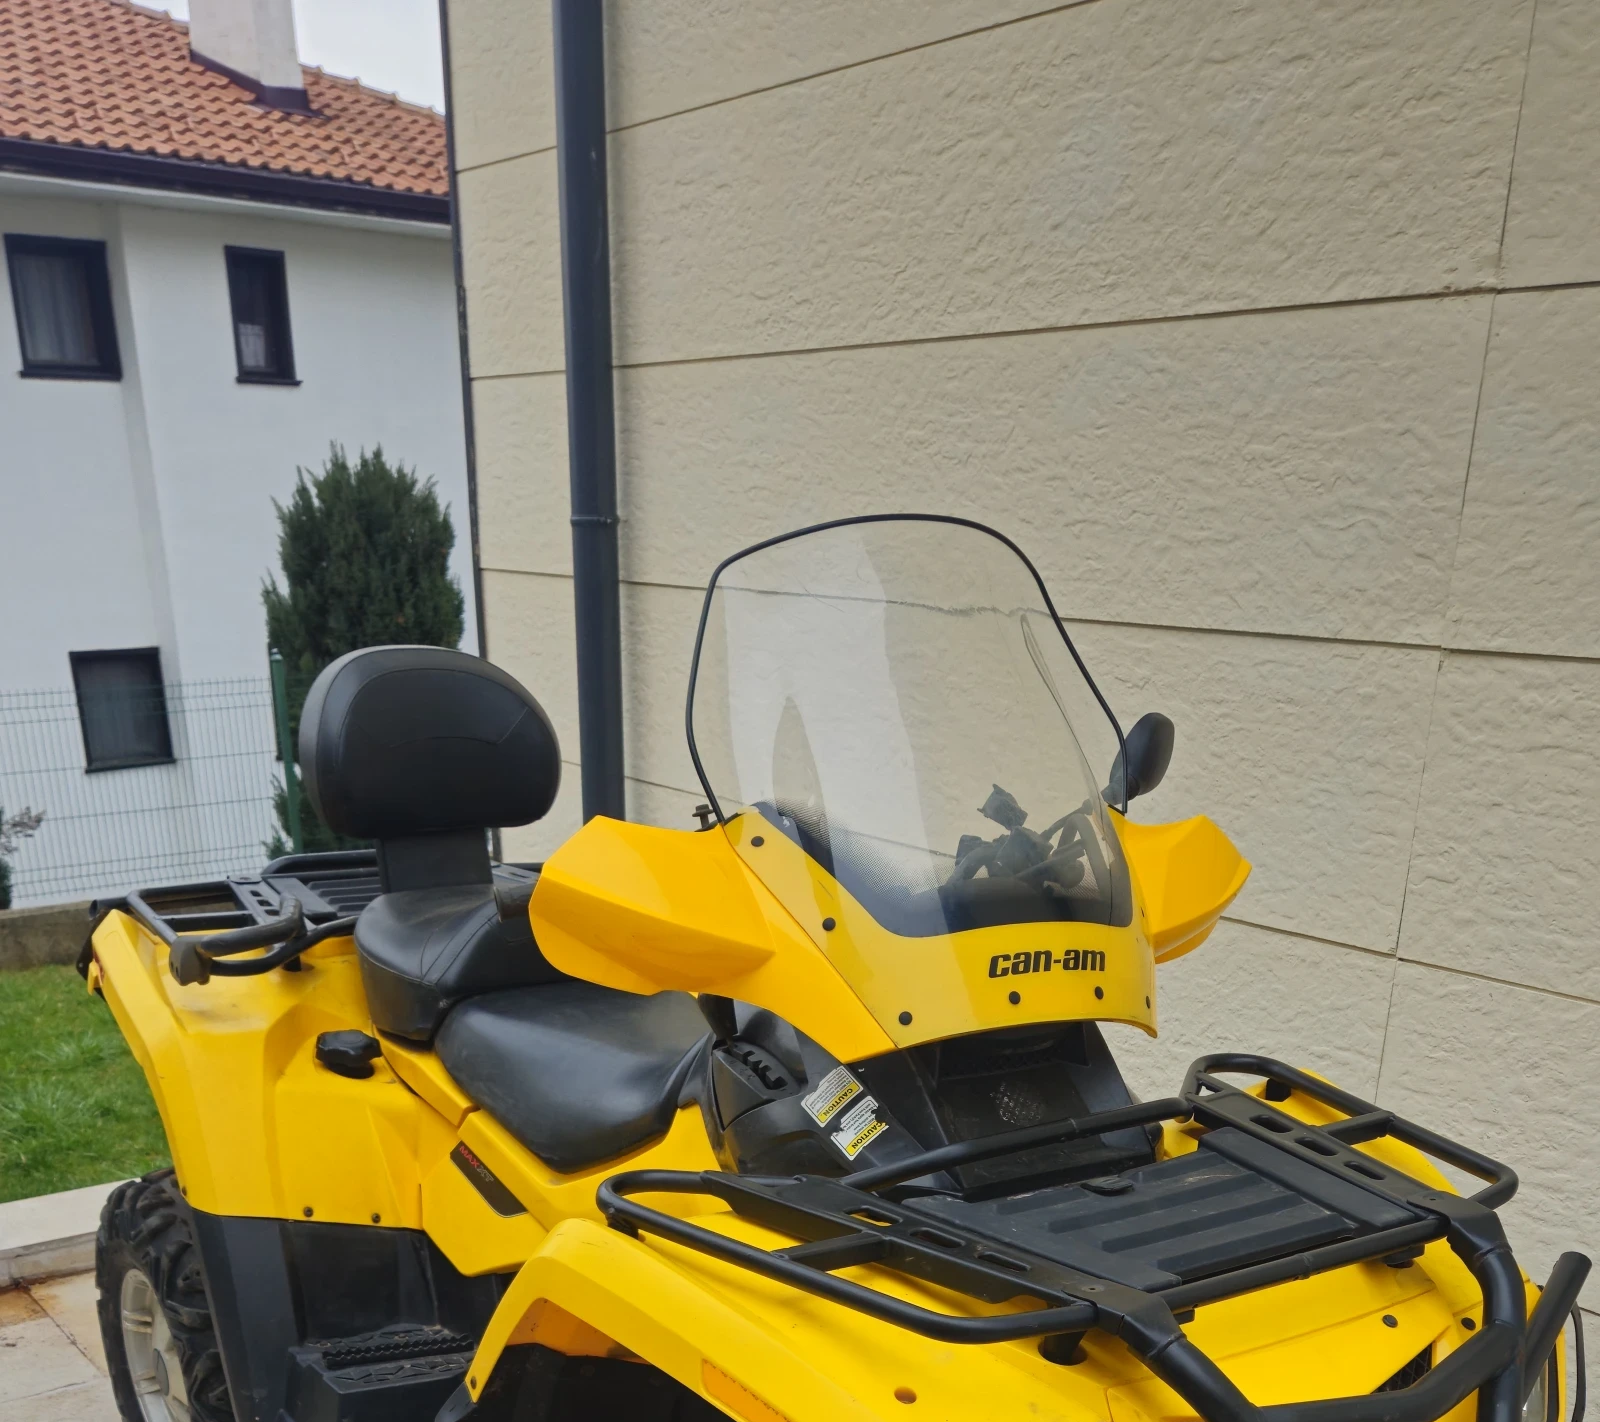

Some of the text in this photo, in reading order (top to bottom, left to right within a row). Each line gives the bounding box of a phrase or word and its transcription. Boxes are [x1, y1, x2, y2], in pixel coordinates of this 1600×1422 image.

[988, 949, 1106, 979] can-am
[823, 1088, 853, 1117] CAUTION
[851, 1121, 883, 1149] CAUTION
